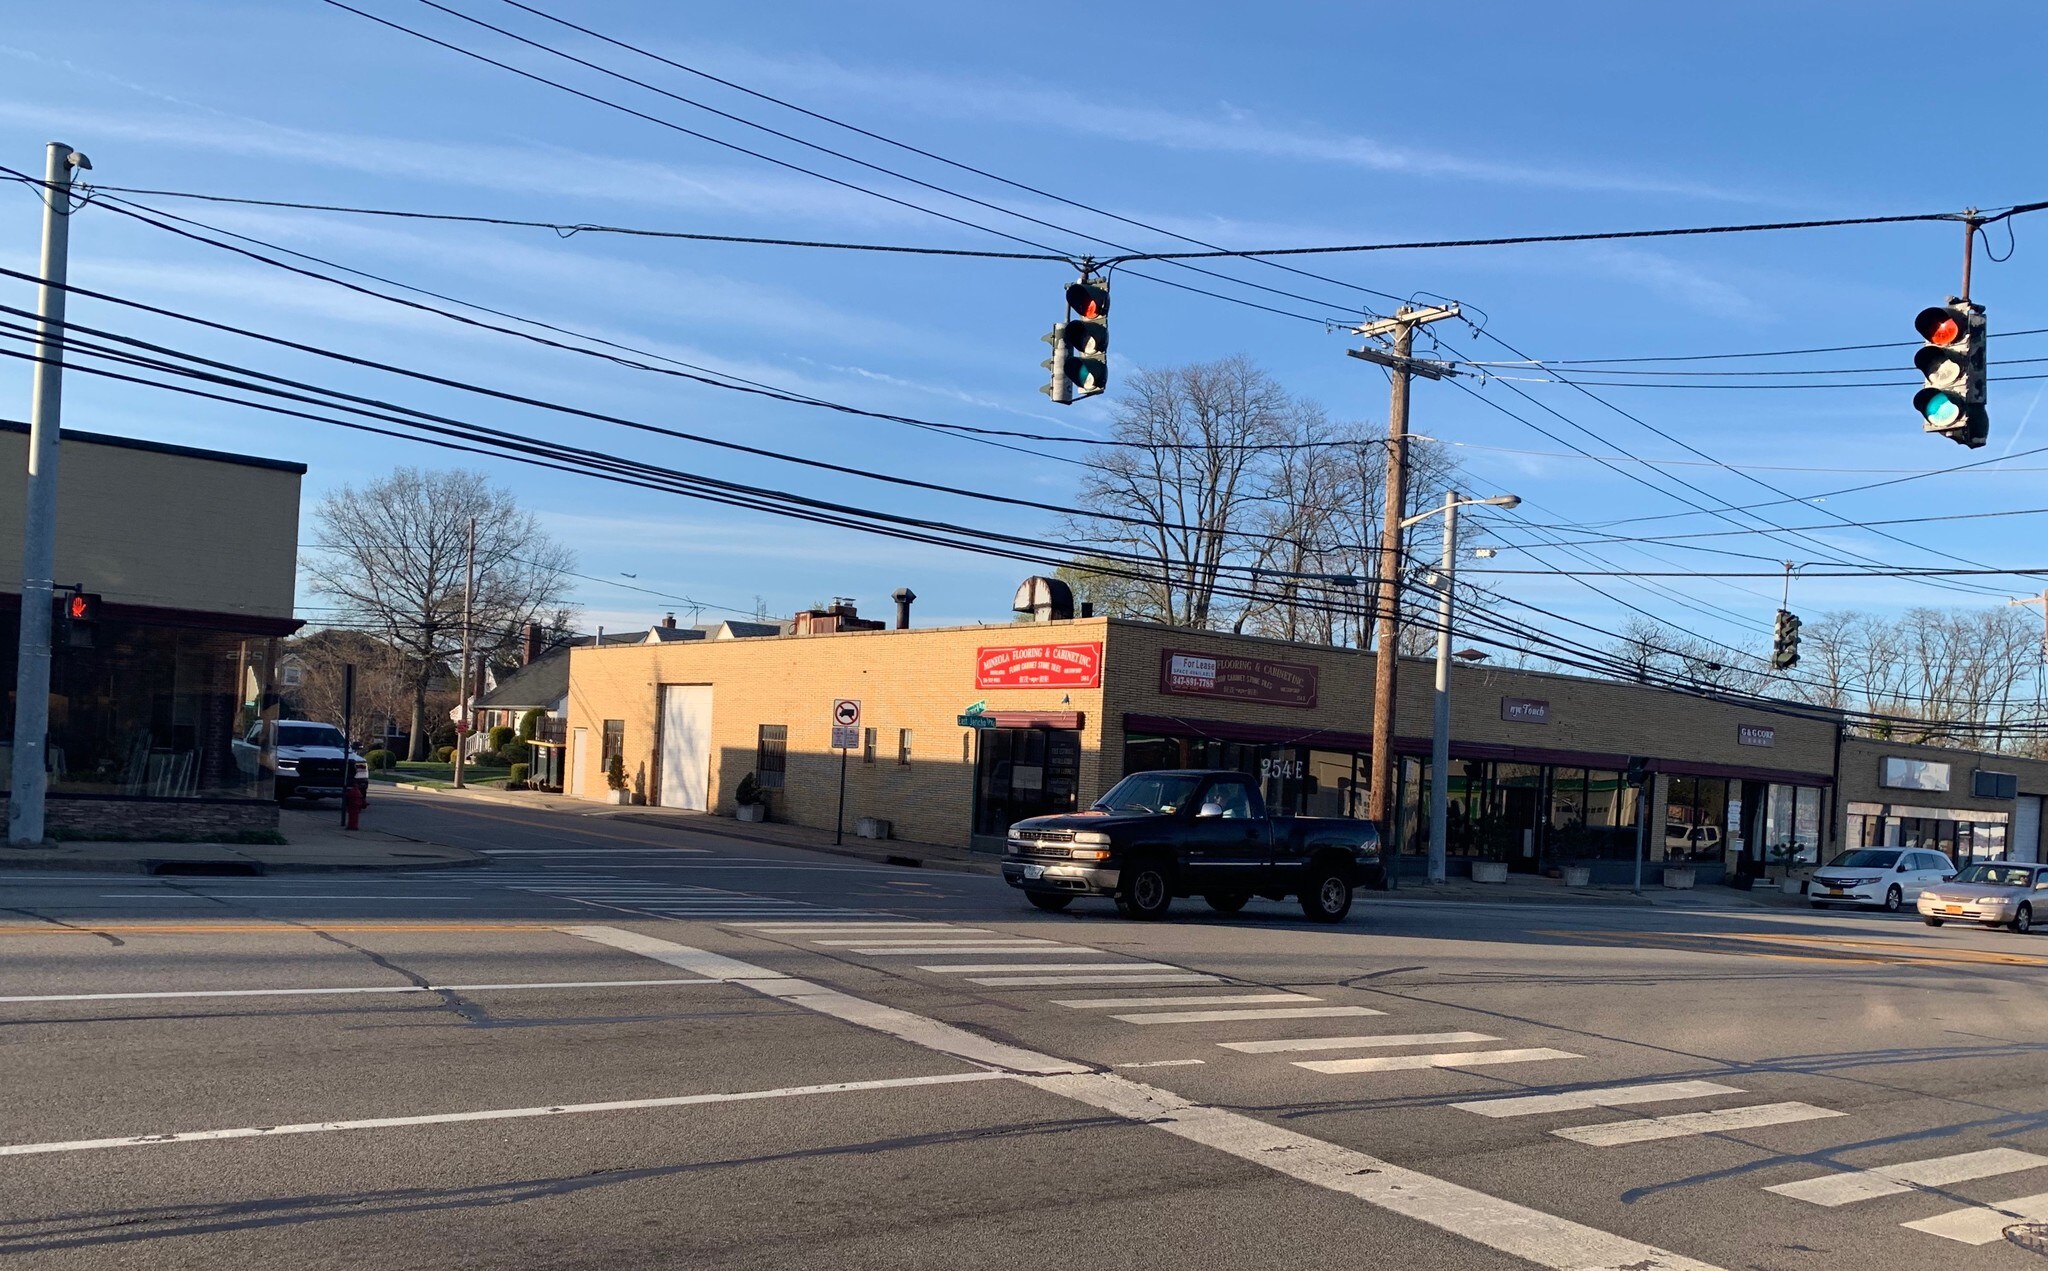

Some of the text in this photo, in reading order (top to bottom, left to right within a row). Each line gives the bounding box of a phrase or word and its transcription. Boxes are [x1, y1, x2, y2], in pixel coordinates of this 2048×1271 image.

[1012, 647, 1043, 660] FLOORING
[1045, 647, 1050, 658] &
[1053, 648, 1080, 664] CABINET
[1183, 658, 1215, 670] For Lease
[1217, 659, 1251, 670] FLOORING
[1255, 662, 1261, 672] &
[1264, 664, 1293, 682] CABINET
[1522, 703, 1545, 717] Touch
[970, 716, 986, 727] Jericho
[1262, 758, 1303, 779] 254 E
